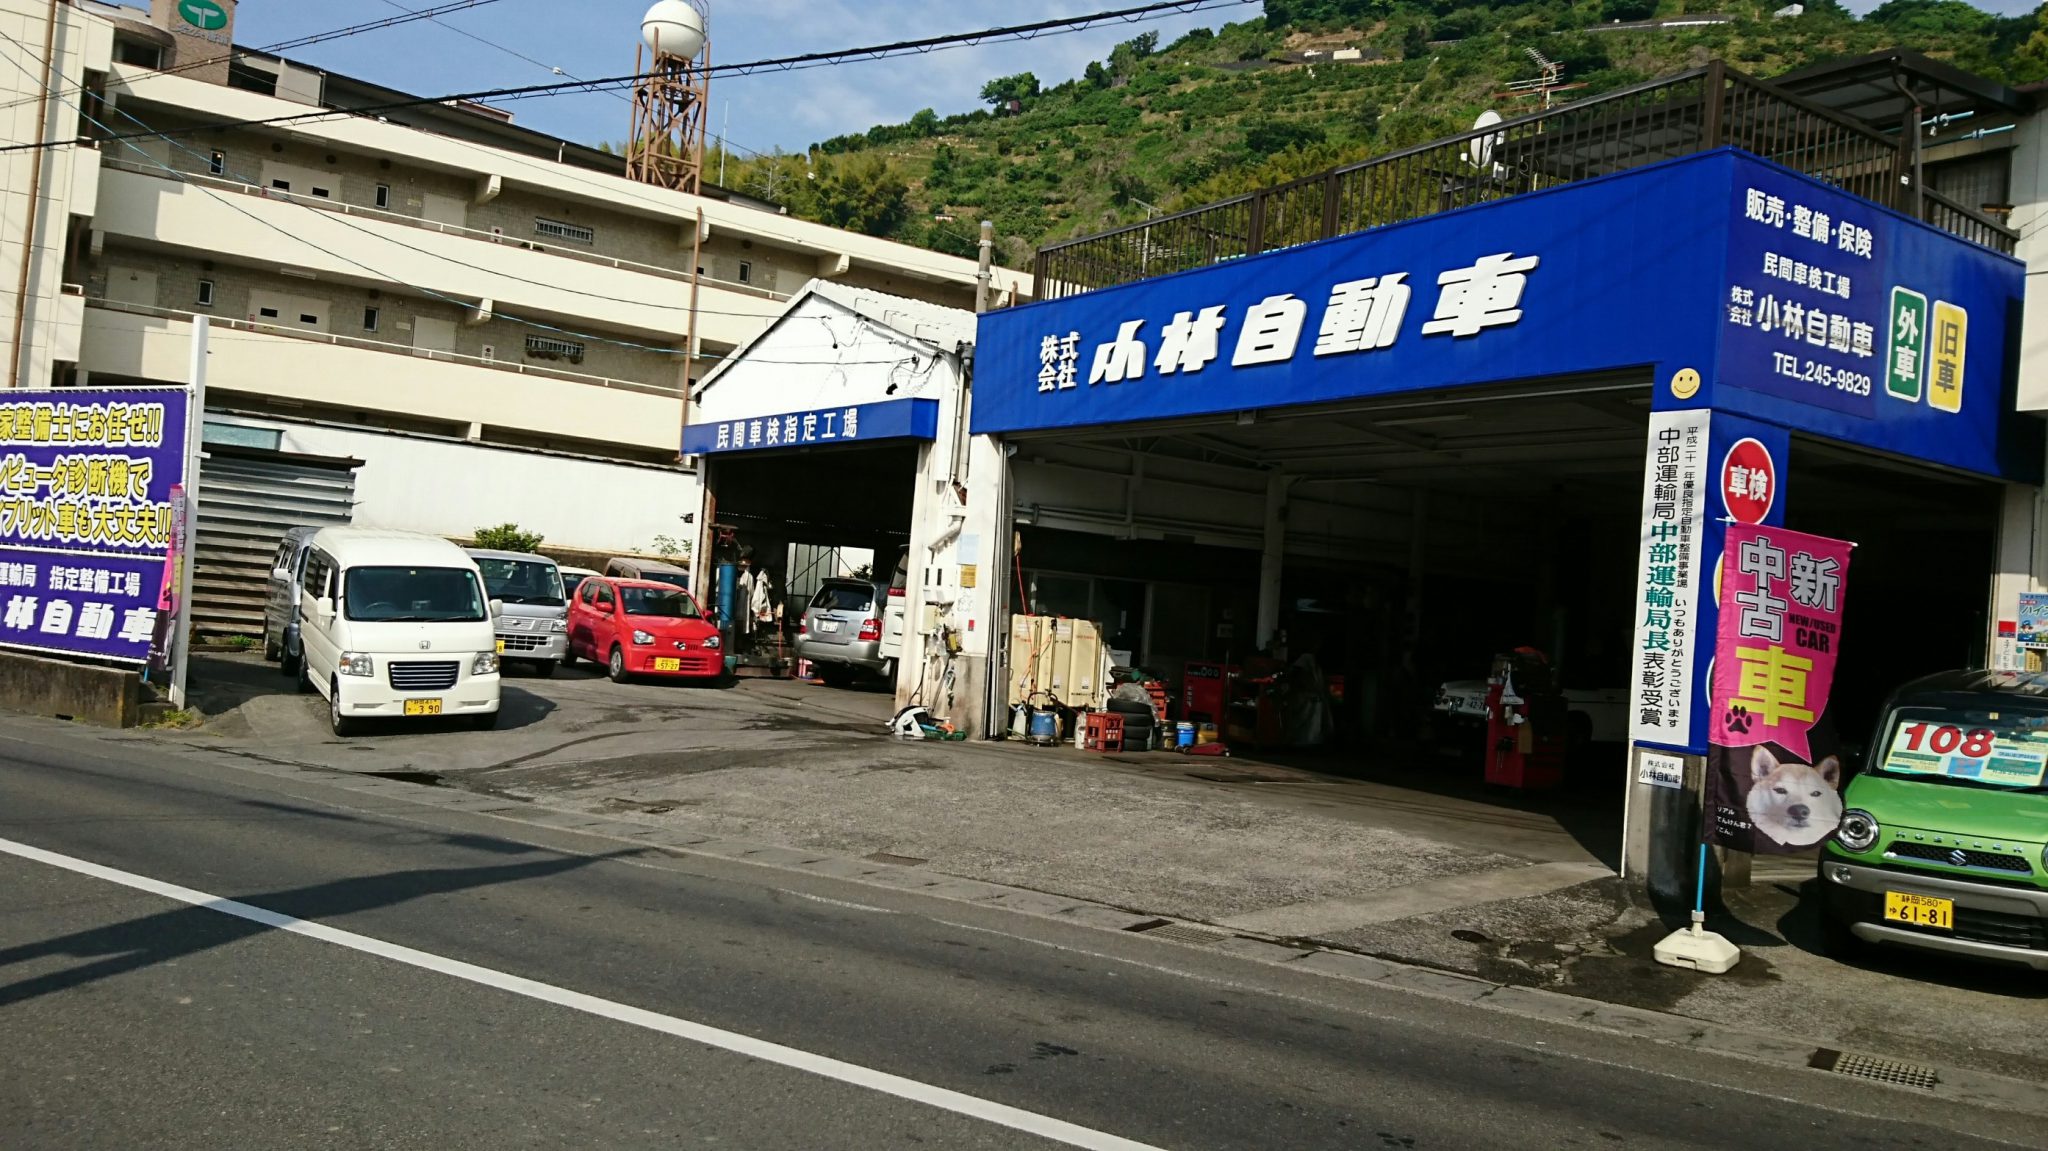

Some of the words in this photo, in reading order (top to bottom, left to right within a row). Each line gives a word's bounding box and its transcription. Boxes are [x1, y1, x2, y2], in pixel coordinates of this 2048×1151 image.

[1763, 251, 1851, 300] 民間車検工場
[1731, 286, 1754, 307] 株式
[1089, 252, 1540, 385] 小林自動車
[1757, 294, 1875, 359] 小林自動車
[1041, 330, 1081, 364] 株式
[1895, 305, 1920, 382] 外車
[1935, 319, 1960, 393] 旧車
[1038, 359, 1077, 392] 会社
[717, 407, 858, 449] 民間車検指定工場
[1728, 465, 1768, 502] 車検
[0, 498, 172, 543] ブリット車も大丈夫!!
[50, 565, 141, 597] 指定整備工場
[1789, 613, 1836, 634] NEW/USED
[1796, 627, 1830, 654] CAR
[1905, 722, 1996, 758] 108
[1900, 905, 1947, 926] 61-81
